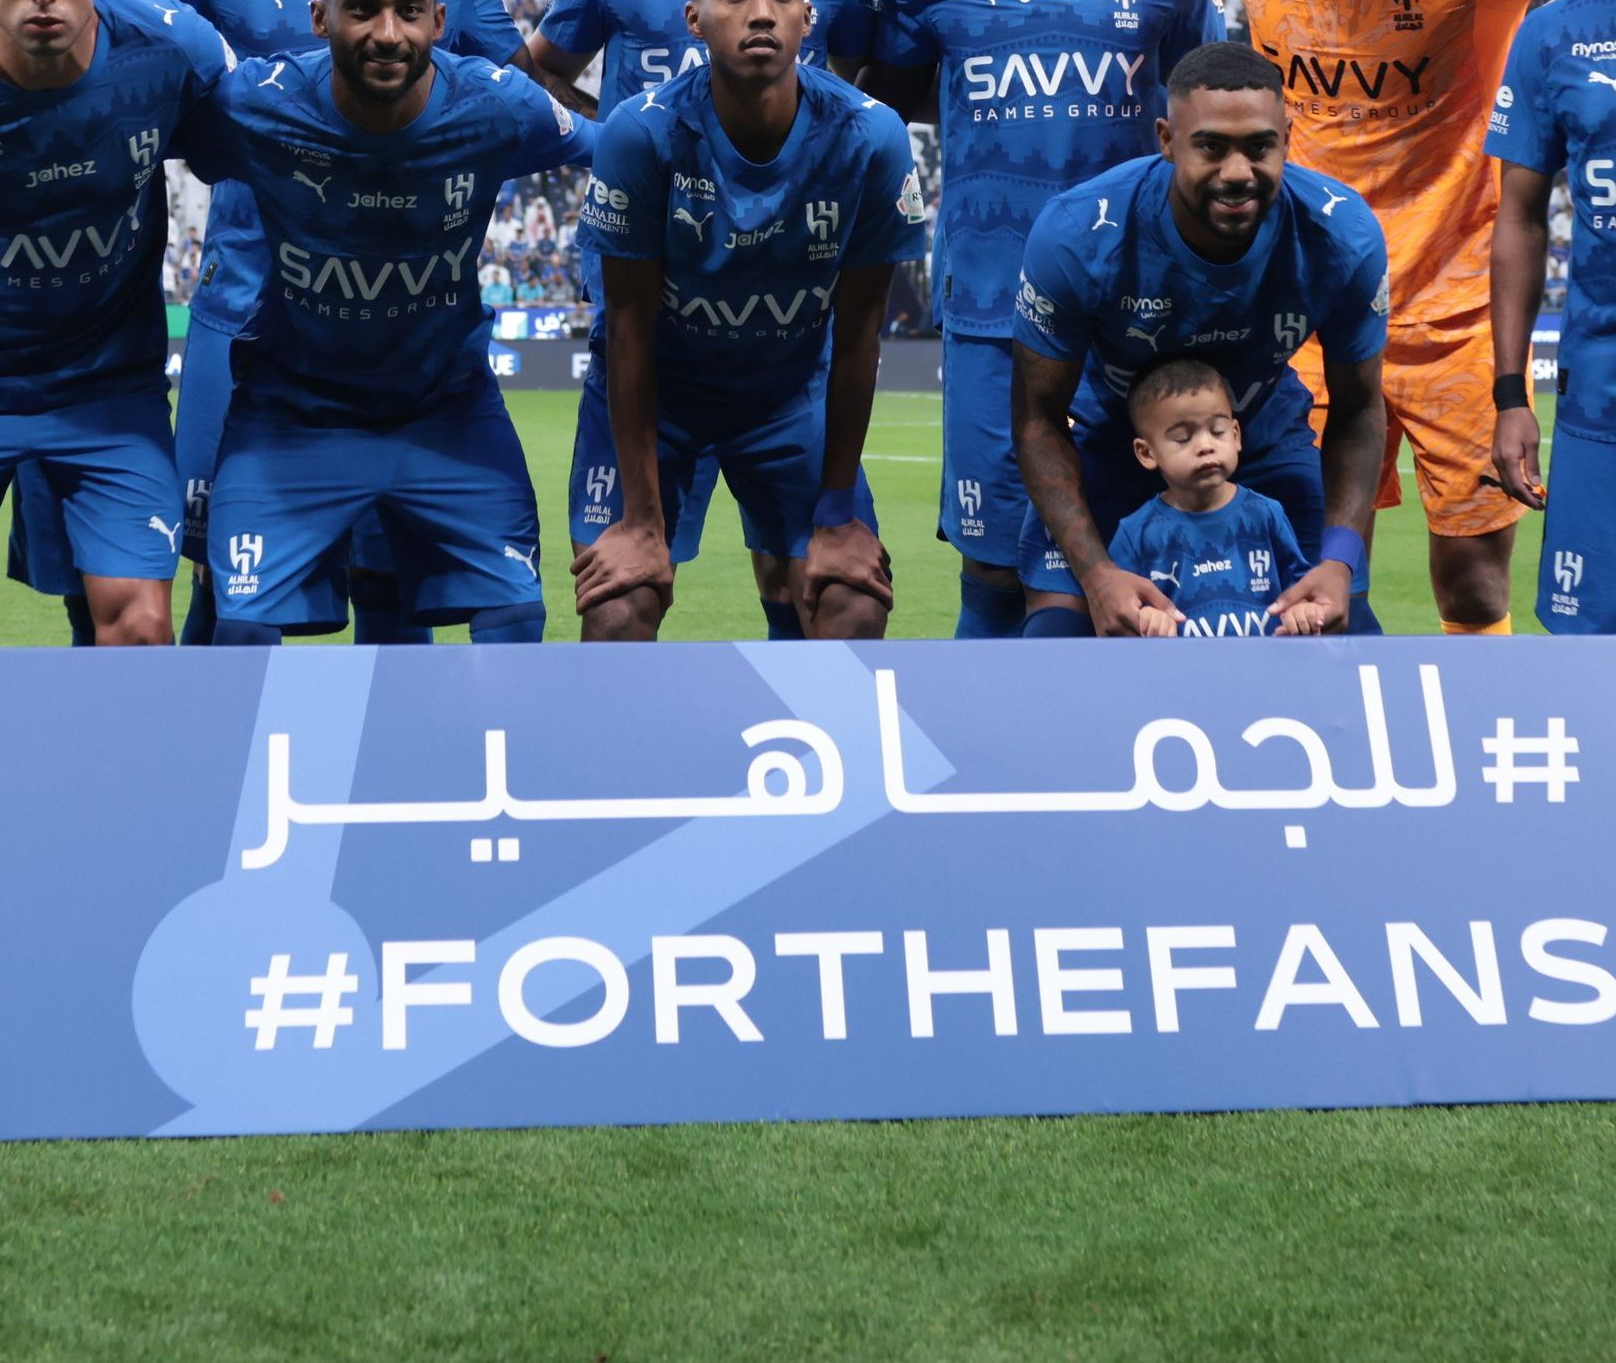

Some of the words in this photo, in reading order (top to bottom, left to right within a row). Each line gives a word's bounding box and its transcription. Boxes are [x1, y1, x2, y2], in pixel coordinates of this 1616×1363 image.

[964, 51, 1145, 101] SAVVY
[974, 104, 1054, 122] GAMES
[1068, 104, 1142, 118] GROUP
[1351, 100, 1436, 120] GROUP
[674, 172, 715, 193] flynas
[279, 237, 472, 300] SAVVY
[284, 287, 372, 320] GAMES
[1121, 296, 1172, 312] flynas
[584, 504, 611, 516] ALHILAL
[229, 574, 260, 585] ALHILAL
[1184, 611, 1271, 637] AVVY
